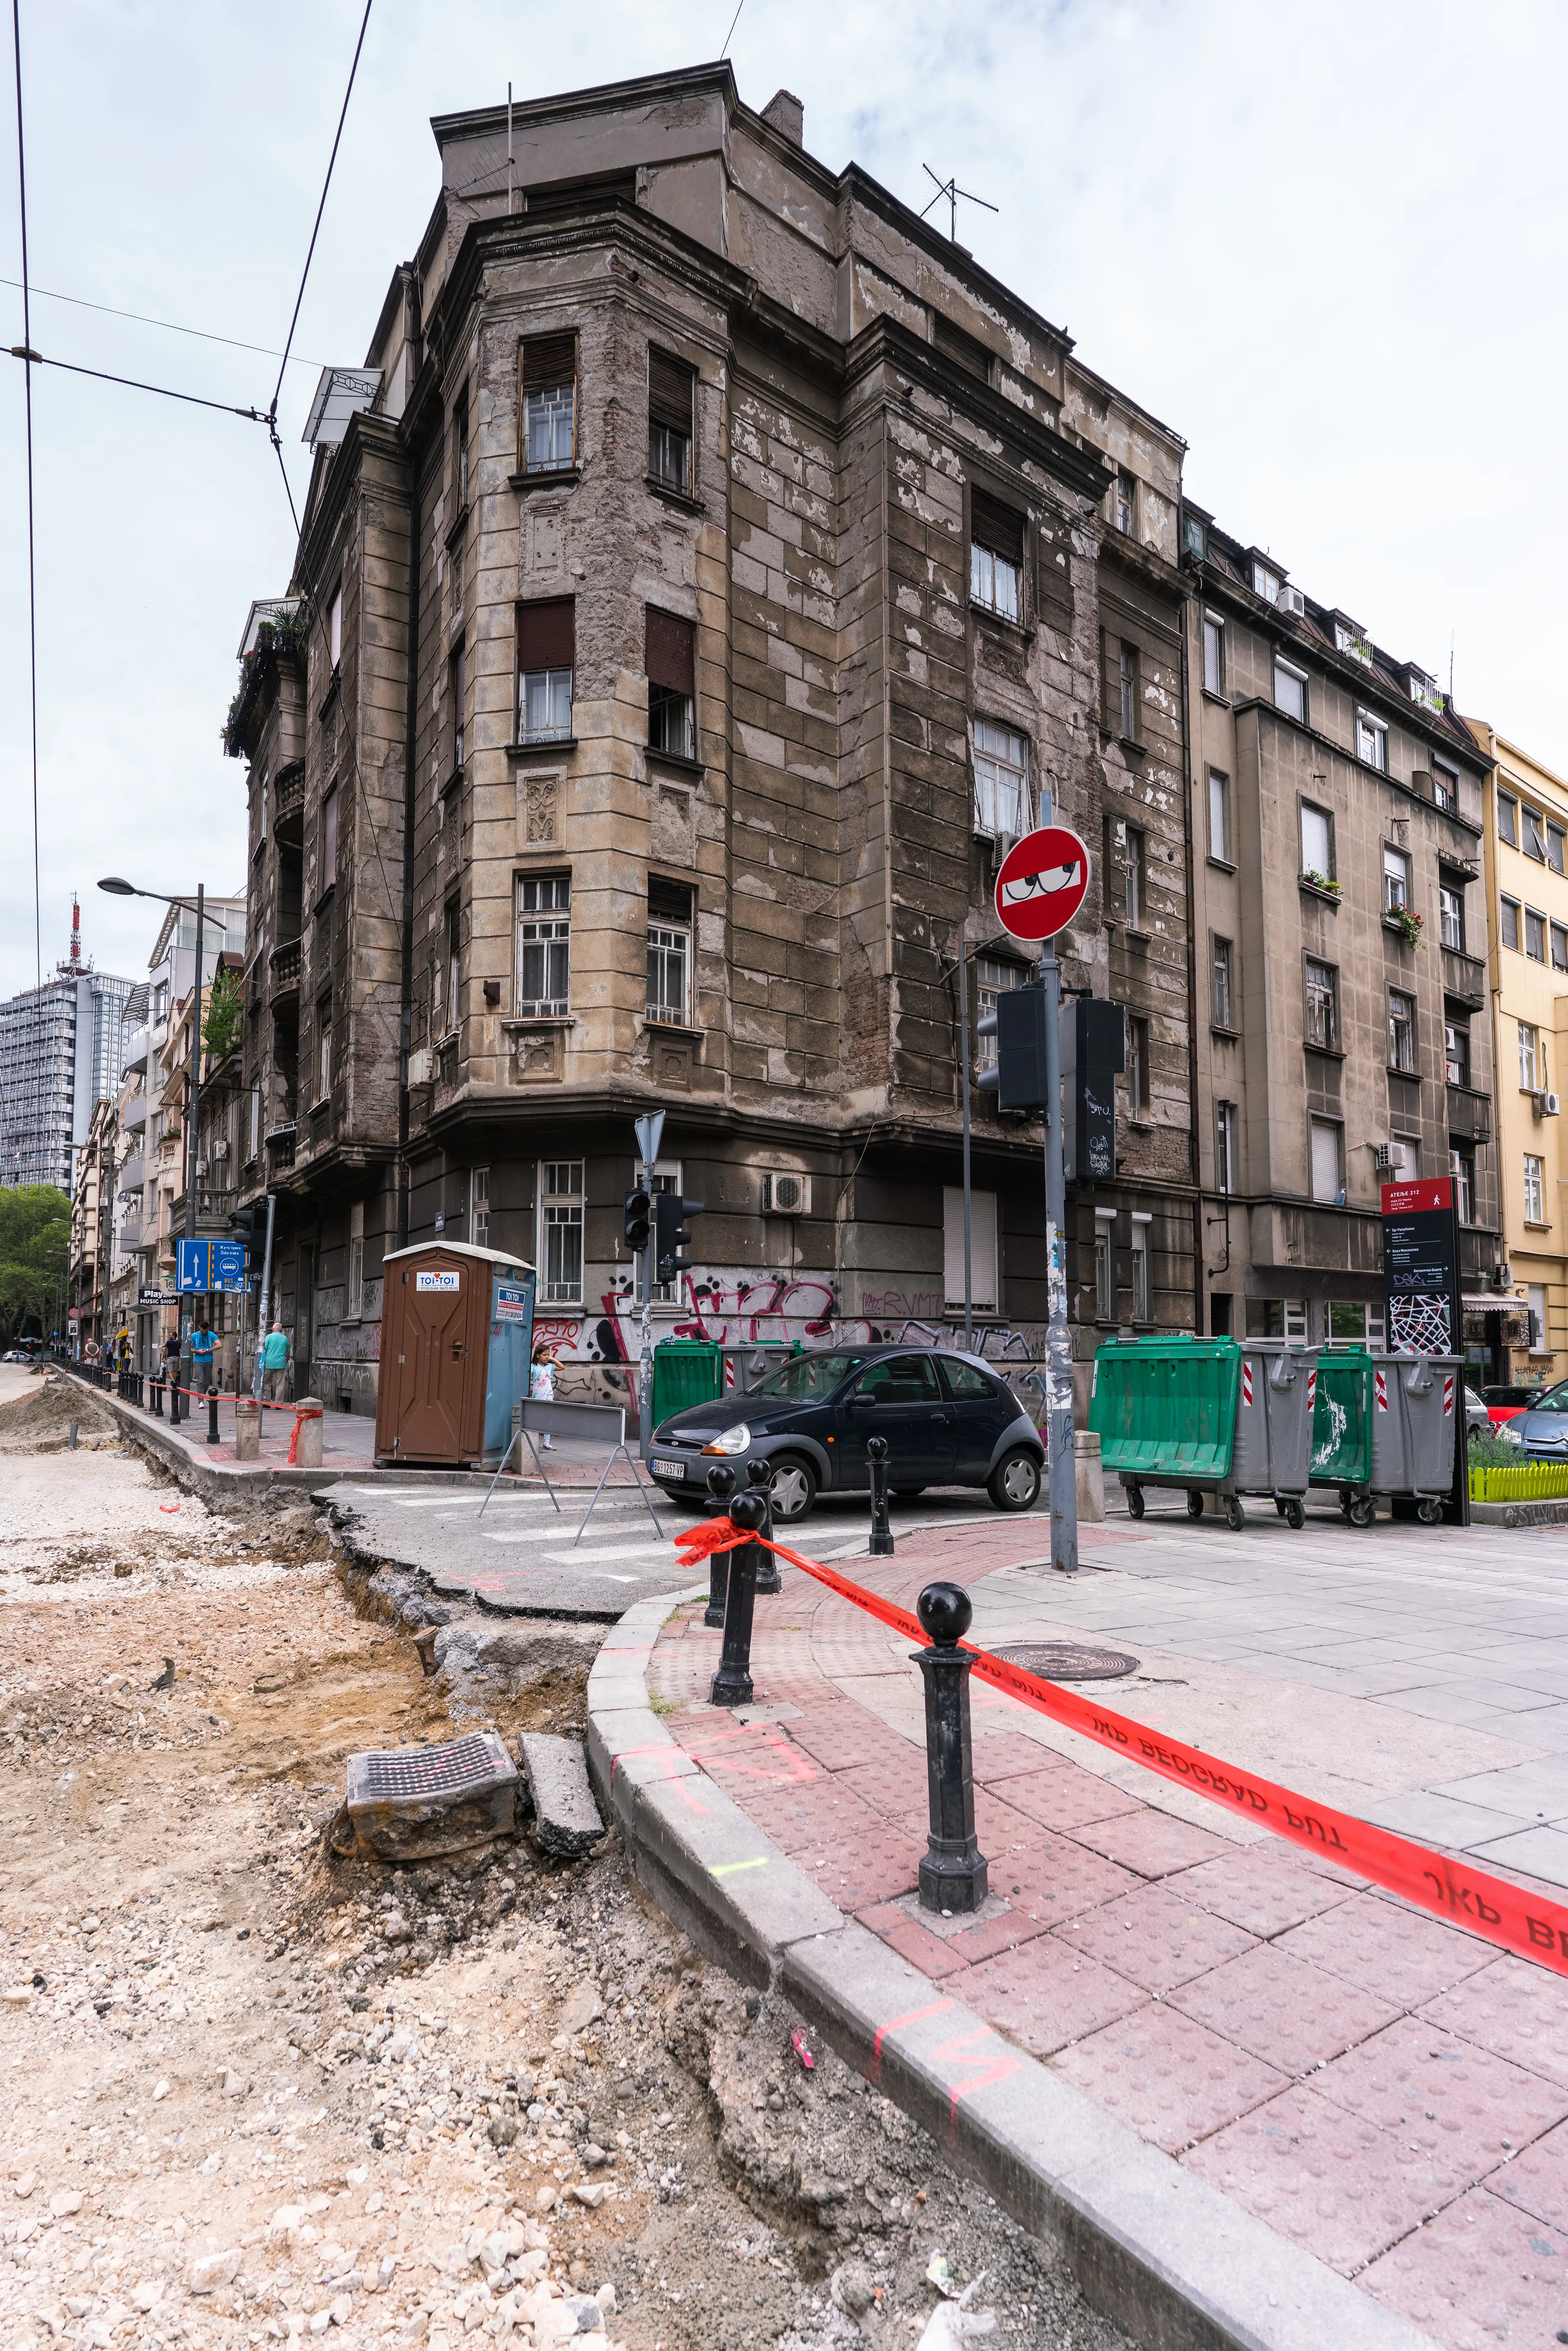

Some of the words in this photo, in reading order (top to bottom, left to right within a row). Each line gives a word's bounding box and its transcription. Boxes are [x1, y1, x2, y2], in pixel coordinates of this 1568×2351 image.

[165, 1279, 175, 1288] Tel
[144, 1290, 167, 1299] Play
[655, 1461, 660, 1472] BG
